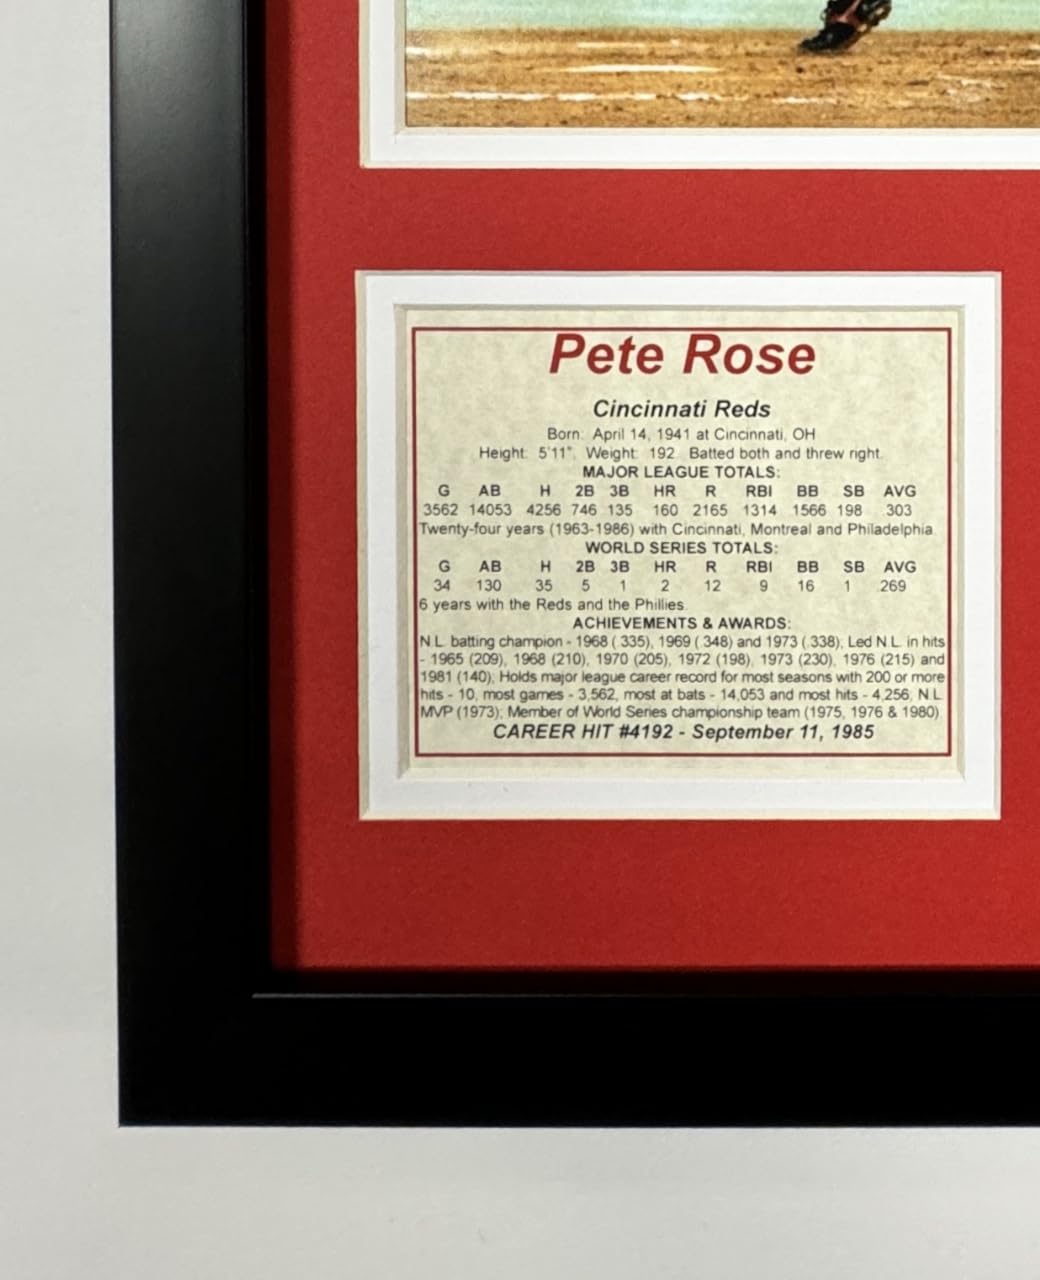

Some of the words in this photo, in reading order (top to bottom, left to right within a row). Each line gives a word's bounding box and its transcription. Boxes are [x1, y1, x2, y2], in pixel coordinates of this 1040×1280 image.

[549, 333, 664, 375] Pete
[682, 333, 816, 375] Rose
[593, 399, 708, 418] Cincinnati
[714, 399, 771, 418] Reds
[592, 427, 624, 443] April
[657, 427, 689, 440] 1941
[696, 429, 709, 440] at
[793, 427, 815, 440] OH
[689, 446, 734, 459] Batted
[740, 447, 770, 460] both
[775, 447, 800, 460] and
[806, 447, 844, 459] threw
[582, 465, 639, 478] MAJOR
[644, 465, 710, 478] LEAGUE
[714, 465, 780, 479] TOTALS:
[438, 484, 450, 497] G
[478, 484, 501, 497] AB
[540, 484, 551, 497] H
[575, 484, 595, 497] 2B
[609, 484, 630, 497] 3B
[654, 485, 676, 497] HR
[705, 485, 716, 497] R
[746, 485, 772, 497] RBI
[797, 485, 819, 497] BB
[843, 485, 865, 498] SB
[883, 485, 916, 497] AVG
[424, 503, 458, 516] 3562
[469, 503, 512, 516] 14053
[526, 503, 561, 516] 4256
[571, 503, 597, 516] 746
[608, 504, 633, 516] 135
[653, 504, 678, 516] 160
[693, 504, 728, 517] 2165
[744, 504, 777, 517] 1314
[793, 504, 827, 517] 1566
[837, 504, 863, 517] 198
[421, 522, 502, 538] Twenty-four
[506, 525, 544, 538] years
[549, 522, 634, 537] (1963-1986)
[638, 523, 667, 535] with
[751, 523, 812, 536] Montreal
[817, 524, 842, 535] and
[585, 541, 645, 554] WORLD
[649, 541, 707, 554] SERIES
[712, 541, 778, 554] TOTALS:
[438, 560, 451, 573] G
[479, 560, 502, 572] AB
[540, 560, 551, 572] H
[576, 560, 595, 573] 2B
[610, 560, 630, 573] 3B
[654, 560, 677, 573] HR
[706, 560, 717, 573] R
[746, 560, 772, 573] RBI
[797, 560, 819, 573] BB
[843, 560, 865, 573] SB
[884, 560, 917, 573] AVG
[434, 579, 450, 592] 34
[476, 579, 502, 592] 130
[536, 579, 553, 592] 35
[582, 579, 590, 592] 5
[620, 580, 625, 591] 1
[661, 579, 669, 592] 2
[705, 579, 721, 592] 12
[760, 579, 768, 592] 9
[798, 580, 815, 592] 16
[845, 580, 849, 592] 1
[419, 598, 428, 611] 6
[433, 600, 471, 613] years
[476, 598, 504, 610] with
[509, 598, 531, 610] the
[536, 598, 572, 611] Reds
[577, 598, 603, 611] and
[608, 598, 630, 611] the
[573, 616, 697, 630] ACHIEVEMENTS
[702, 617, 713, 630] &
[718, 617, 791, 630] AWARDS:
[451, 635, 495, 650] batting
[499, 635, 563, 650] champion
[576, 635, 608, 648] 1968
[659, 635, 691, 648] 1969
[737, 636, 762, 648] and
[766, 635, 798, 648] 1973
[848, 635, 872, 648] Led
[907, 636, 918, 648] in
[922, 636, 945, 648] hits
[431, 652, 464, 665] 1965
[514, 652, 546, 666] 1968
[596, 652, 629, 665] 1970
[678, 653, 711, 665] 1972
[760, 653, 793, 666] 1973
[843, 653, 875, 665] 1976
[881, 653, 915, 667] (215)
[920, 653, 945, 665] and
[421, 670, 451, 683] 1981
[499, 670, 538, 683] Holds
[541, 673, 578, 686] major
[581, 671, 626, 686] league
[629, 673, 672, 683] career
[675, 671, 717, 683] record
[720, 670, 738, 683] for
[741, 672, 774, 683] most
[777, 673, 833, 683] seasons
[836, 671, 862, 683] with
[866, 670, 891, 683] 200
[894, 673, 908, 683] or
[911, 673, 945, 683] more
[420, 688, 444, 700] hits
[483, 689, 515, 700] most
[519, 690, 564, 703] games
[624, 689, 656, 701] most
[660, 689, 672, 700] at
[677, 688, 706, 700] bats
[721, 688, 765, 702] 14,053
[769, 688, 794, 701] and
[798, 689, 831, 701] most
[835, 688, 858, 701] hits
[421, 705, 454, 718] MVP
[507, 705, 563, 718] Member
[566, 705, 579, 718] of
[583, 705, 621, 718] World
[625, 705, 668, 718] Series
[671, 706, 763, 720] championship
[766, 707, 800, 718] team
[851, 706, 883, 718] 1976
[888, 706, 898, 718] &
[493, 723, 576, 739] CAREER
[581, 723, 615, 739] HIT
[618, 724, 673, 739] #4192
[692, 723, 794, 743] September
[832, 724, 875, 739] 1985
